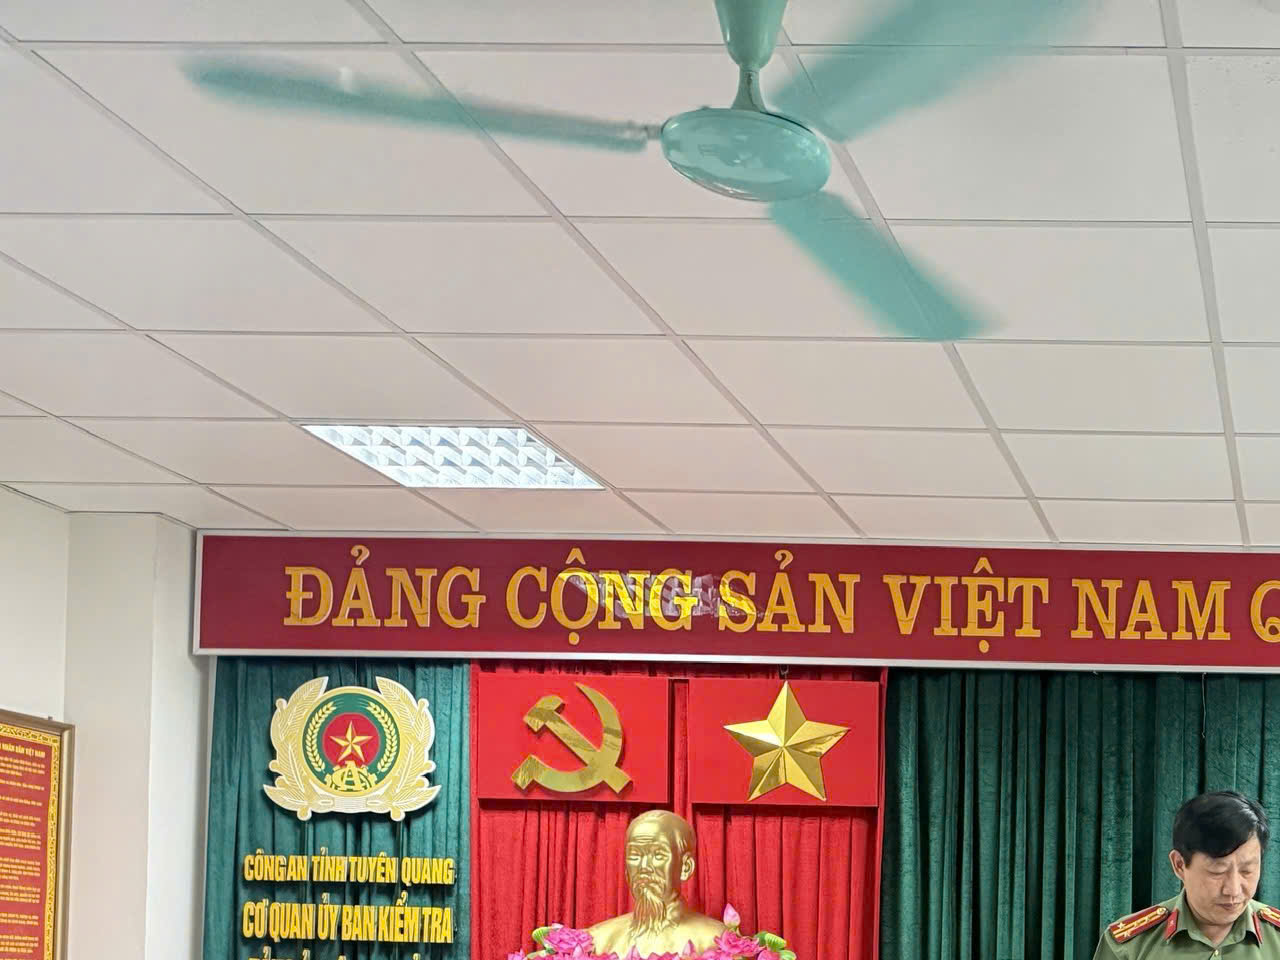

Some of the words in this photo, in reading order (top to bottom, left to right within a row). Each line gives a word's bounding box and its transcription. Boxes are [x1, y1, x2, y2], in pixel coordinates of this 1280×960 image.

[283, 545, 484, 629] ĐẢNG
[505, 547, 698, 646] CỘNG
[716, 550, 860, 633] SẢN
[882, 557, 1049, 653] VIỆT
[1070, 578, 1232, 641] NAM
[244, 848, 286, 881] CÔNG
[287, 855, 309, 881] AN
[312, 847, 347, 882] TỈNH
[348, 852, 399, 883] TUYÊN
[401, 857, 455, 886] QUANG
[242, 899, 268, 938] CƠ
[269, 902, 316, 942] QUAN
[317, 893, 341, 940] ỦY
[341, 904, 377, 941] BAN
[378, 890, 421, 942] KIỂM
[422, 907, 453, 943] TRA
